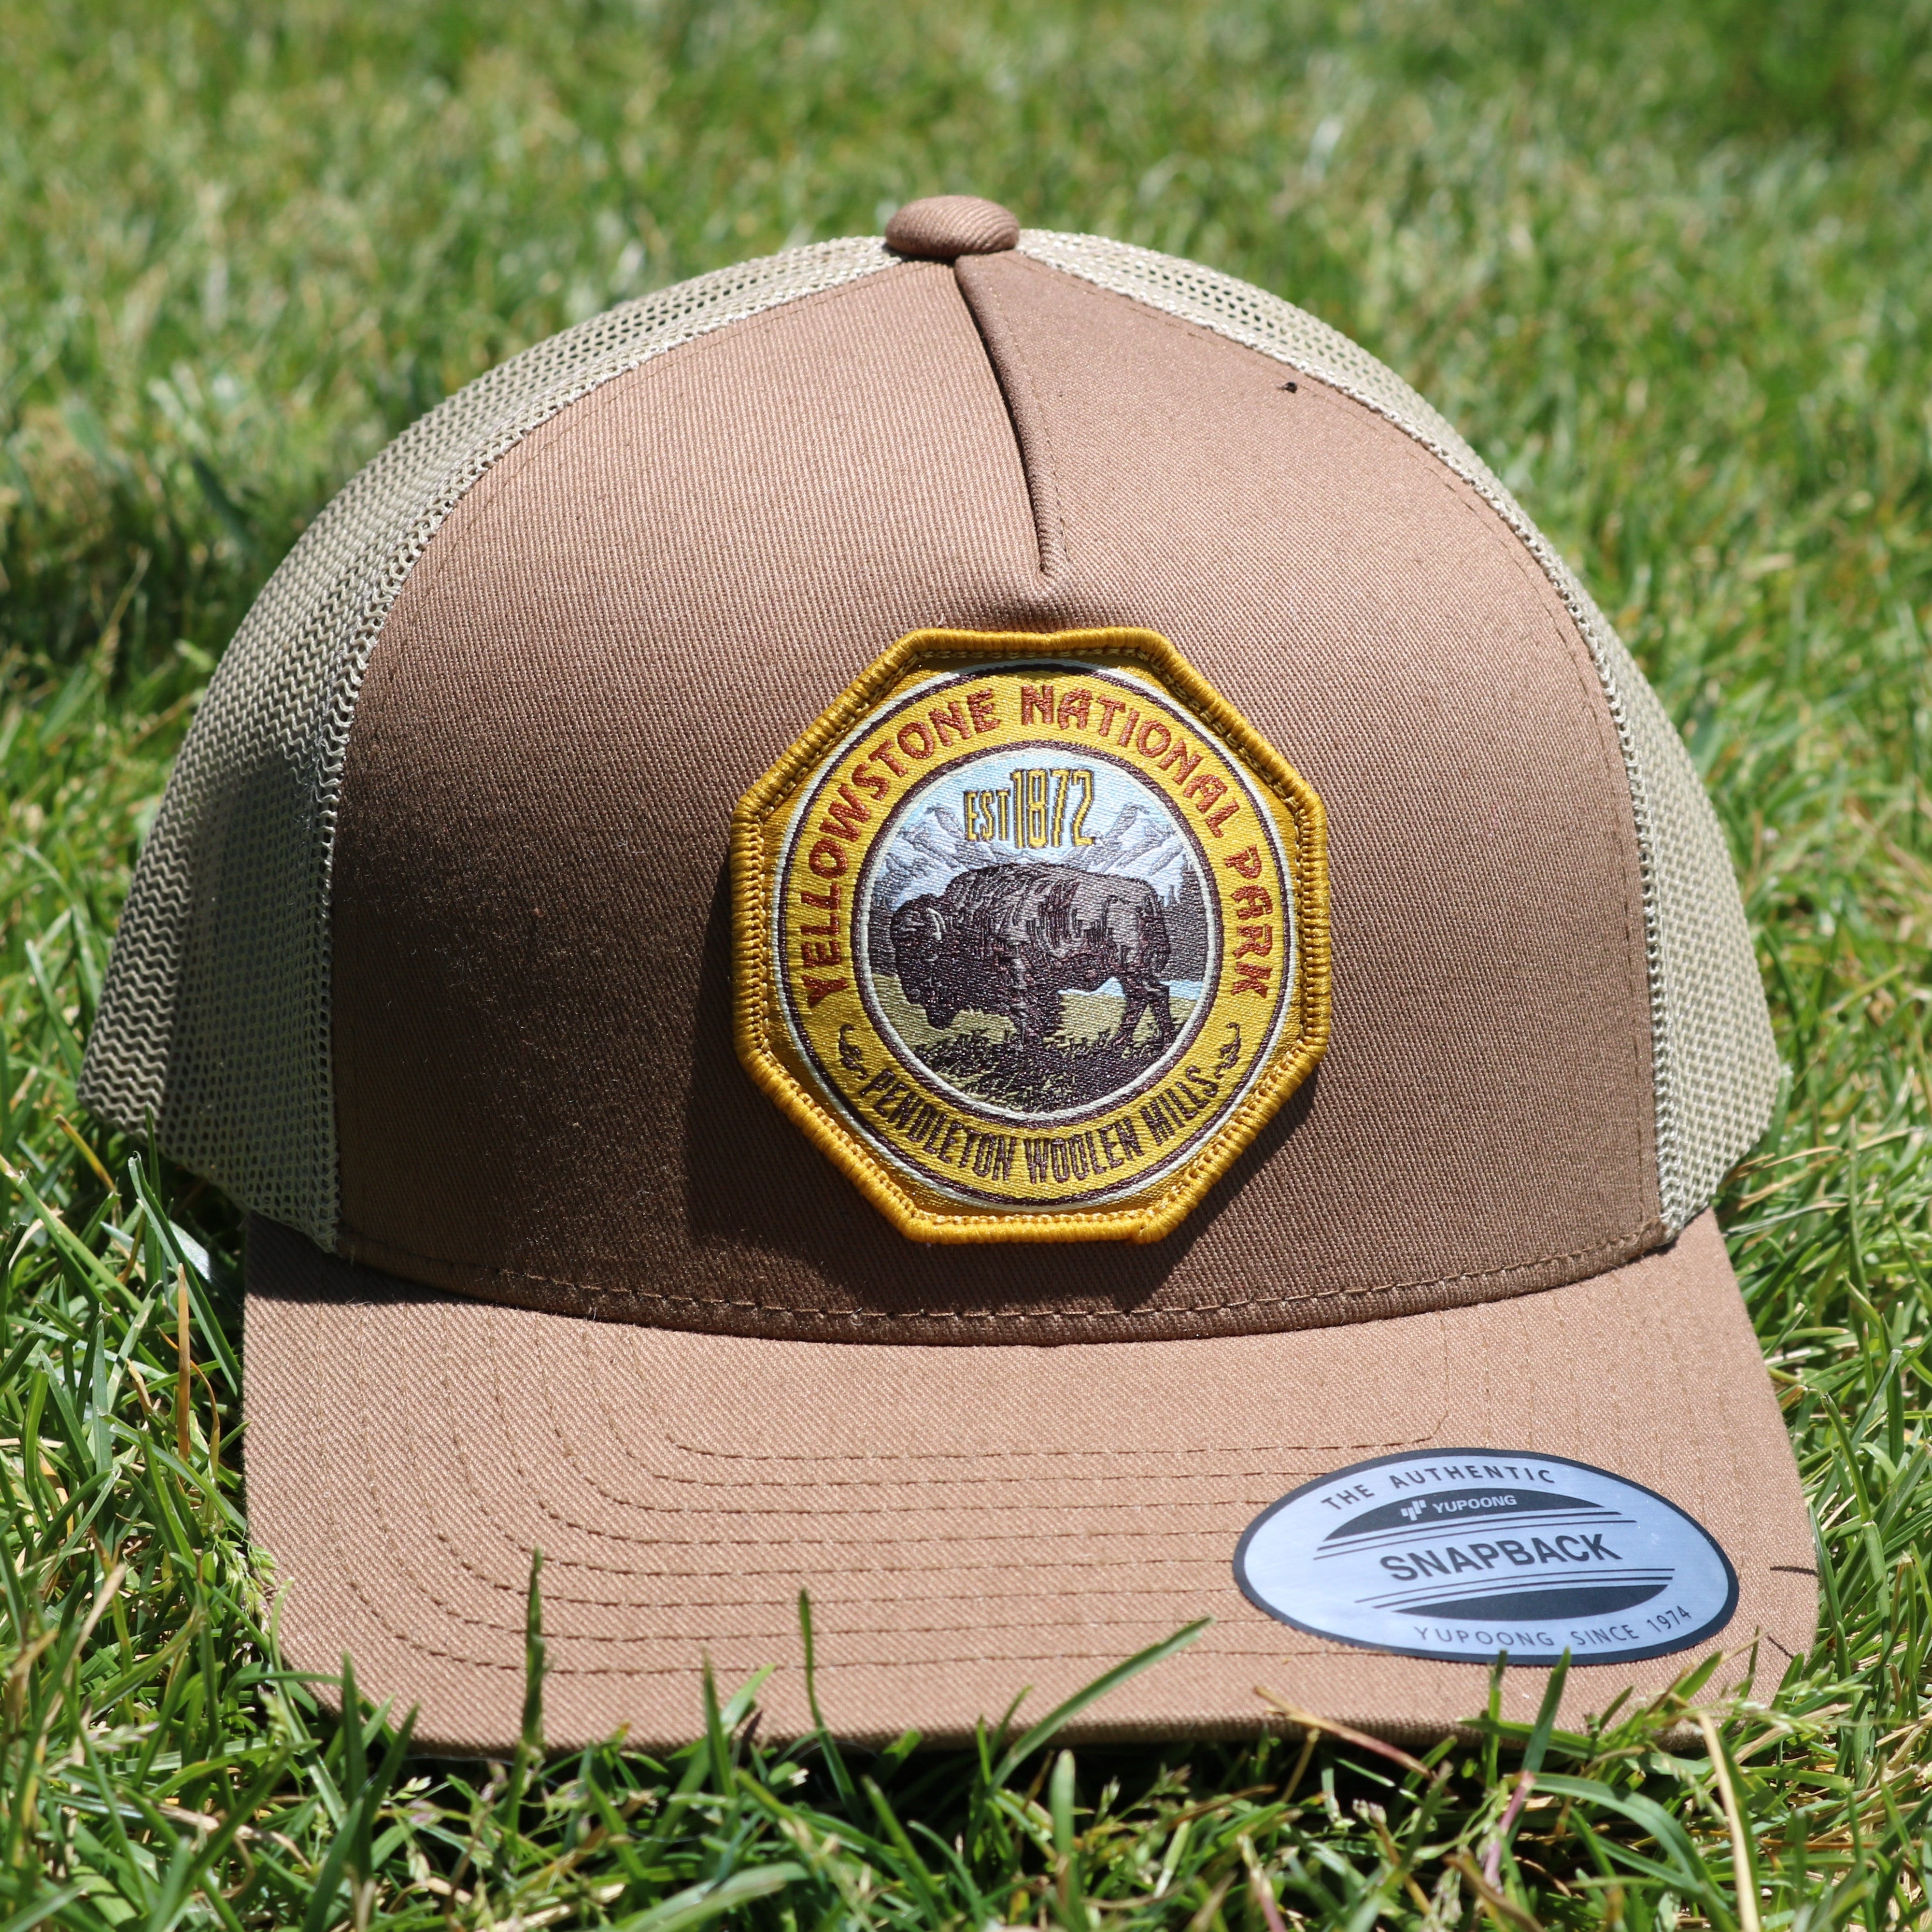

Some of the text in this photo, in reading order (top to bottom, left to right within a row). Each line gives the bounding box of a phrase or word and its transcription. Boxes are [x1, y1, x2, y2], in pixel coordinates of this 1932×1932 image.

[1010, 769, 1094, 848] 1872
[802, 685, 1272, 1006] YELLOWSTONE NATIONAL PARK
[862, 1067, 1219, 1183] PENDLETON WOOLEN MILLS
[1321, 1465, 1555, 1511] THE AUTHENTIC
[1433, 1495, 1517, 1514] YUPOONG
[1380, 1534, 1622, 1582] SNAPBACK
[1416, 1605, 1692, 1648] YUPOONG SINCE 1974
